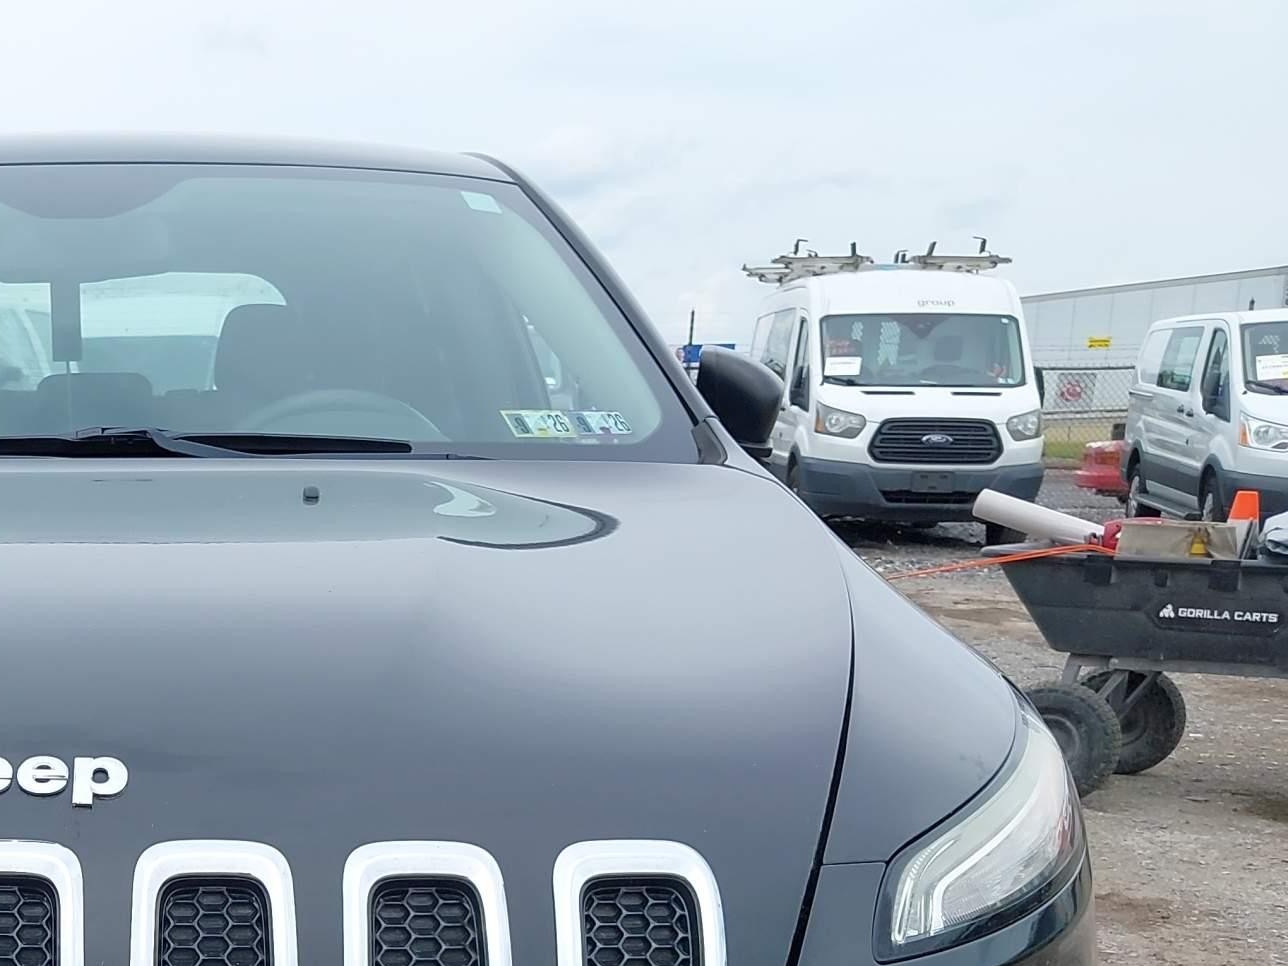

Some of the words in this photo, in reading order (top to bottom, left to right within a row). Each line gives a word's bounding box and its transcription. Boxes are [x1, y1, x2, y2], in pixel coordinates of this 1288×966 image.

[917, 299, 955, 308] group
[1178, 607, 1231, 620] GORILLA
[1234, 611, 1279, 623] CARTS
